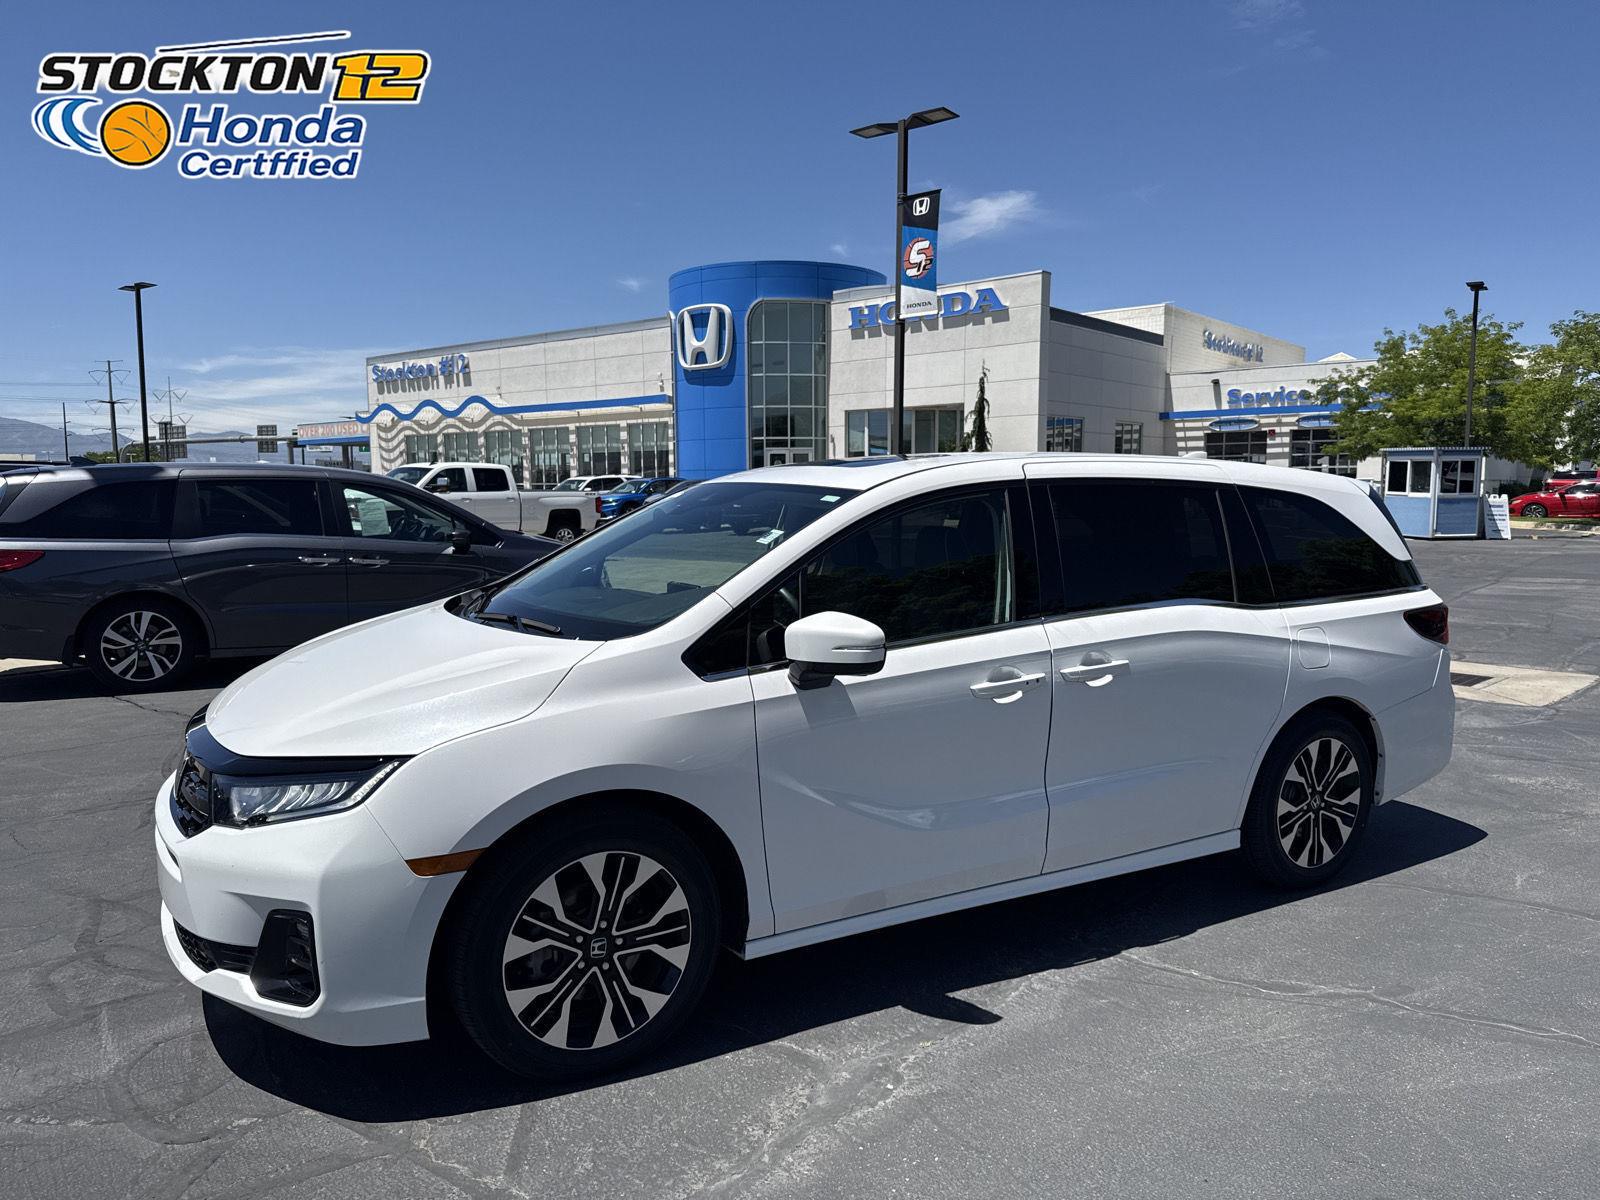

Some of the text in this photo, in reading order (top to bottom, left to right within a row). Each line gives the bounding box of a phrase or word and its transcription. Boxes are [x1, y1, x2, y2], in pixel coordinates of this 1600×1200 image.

[848, 287, 1010, 329] HODA
[906, 300, 933, 309] HONDA
[372, 353, 468, 382] Stockton #12
[300, 427, 320, 438] OVER
[321, 425, 335, 436] 200
[336, 422, 359, 435] USED
